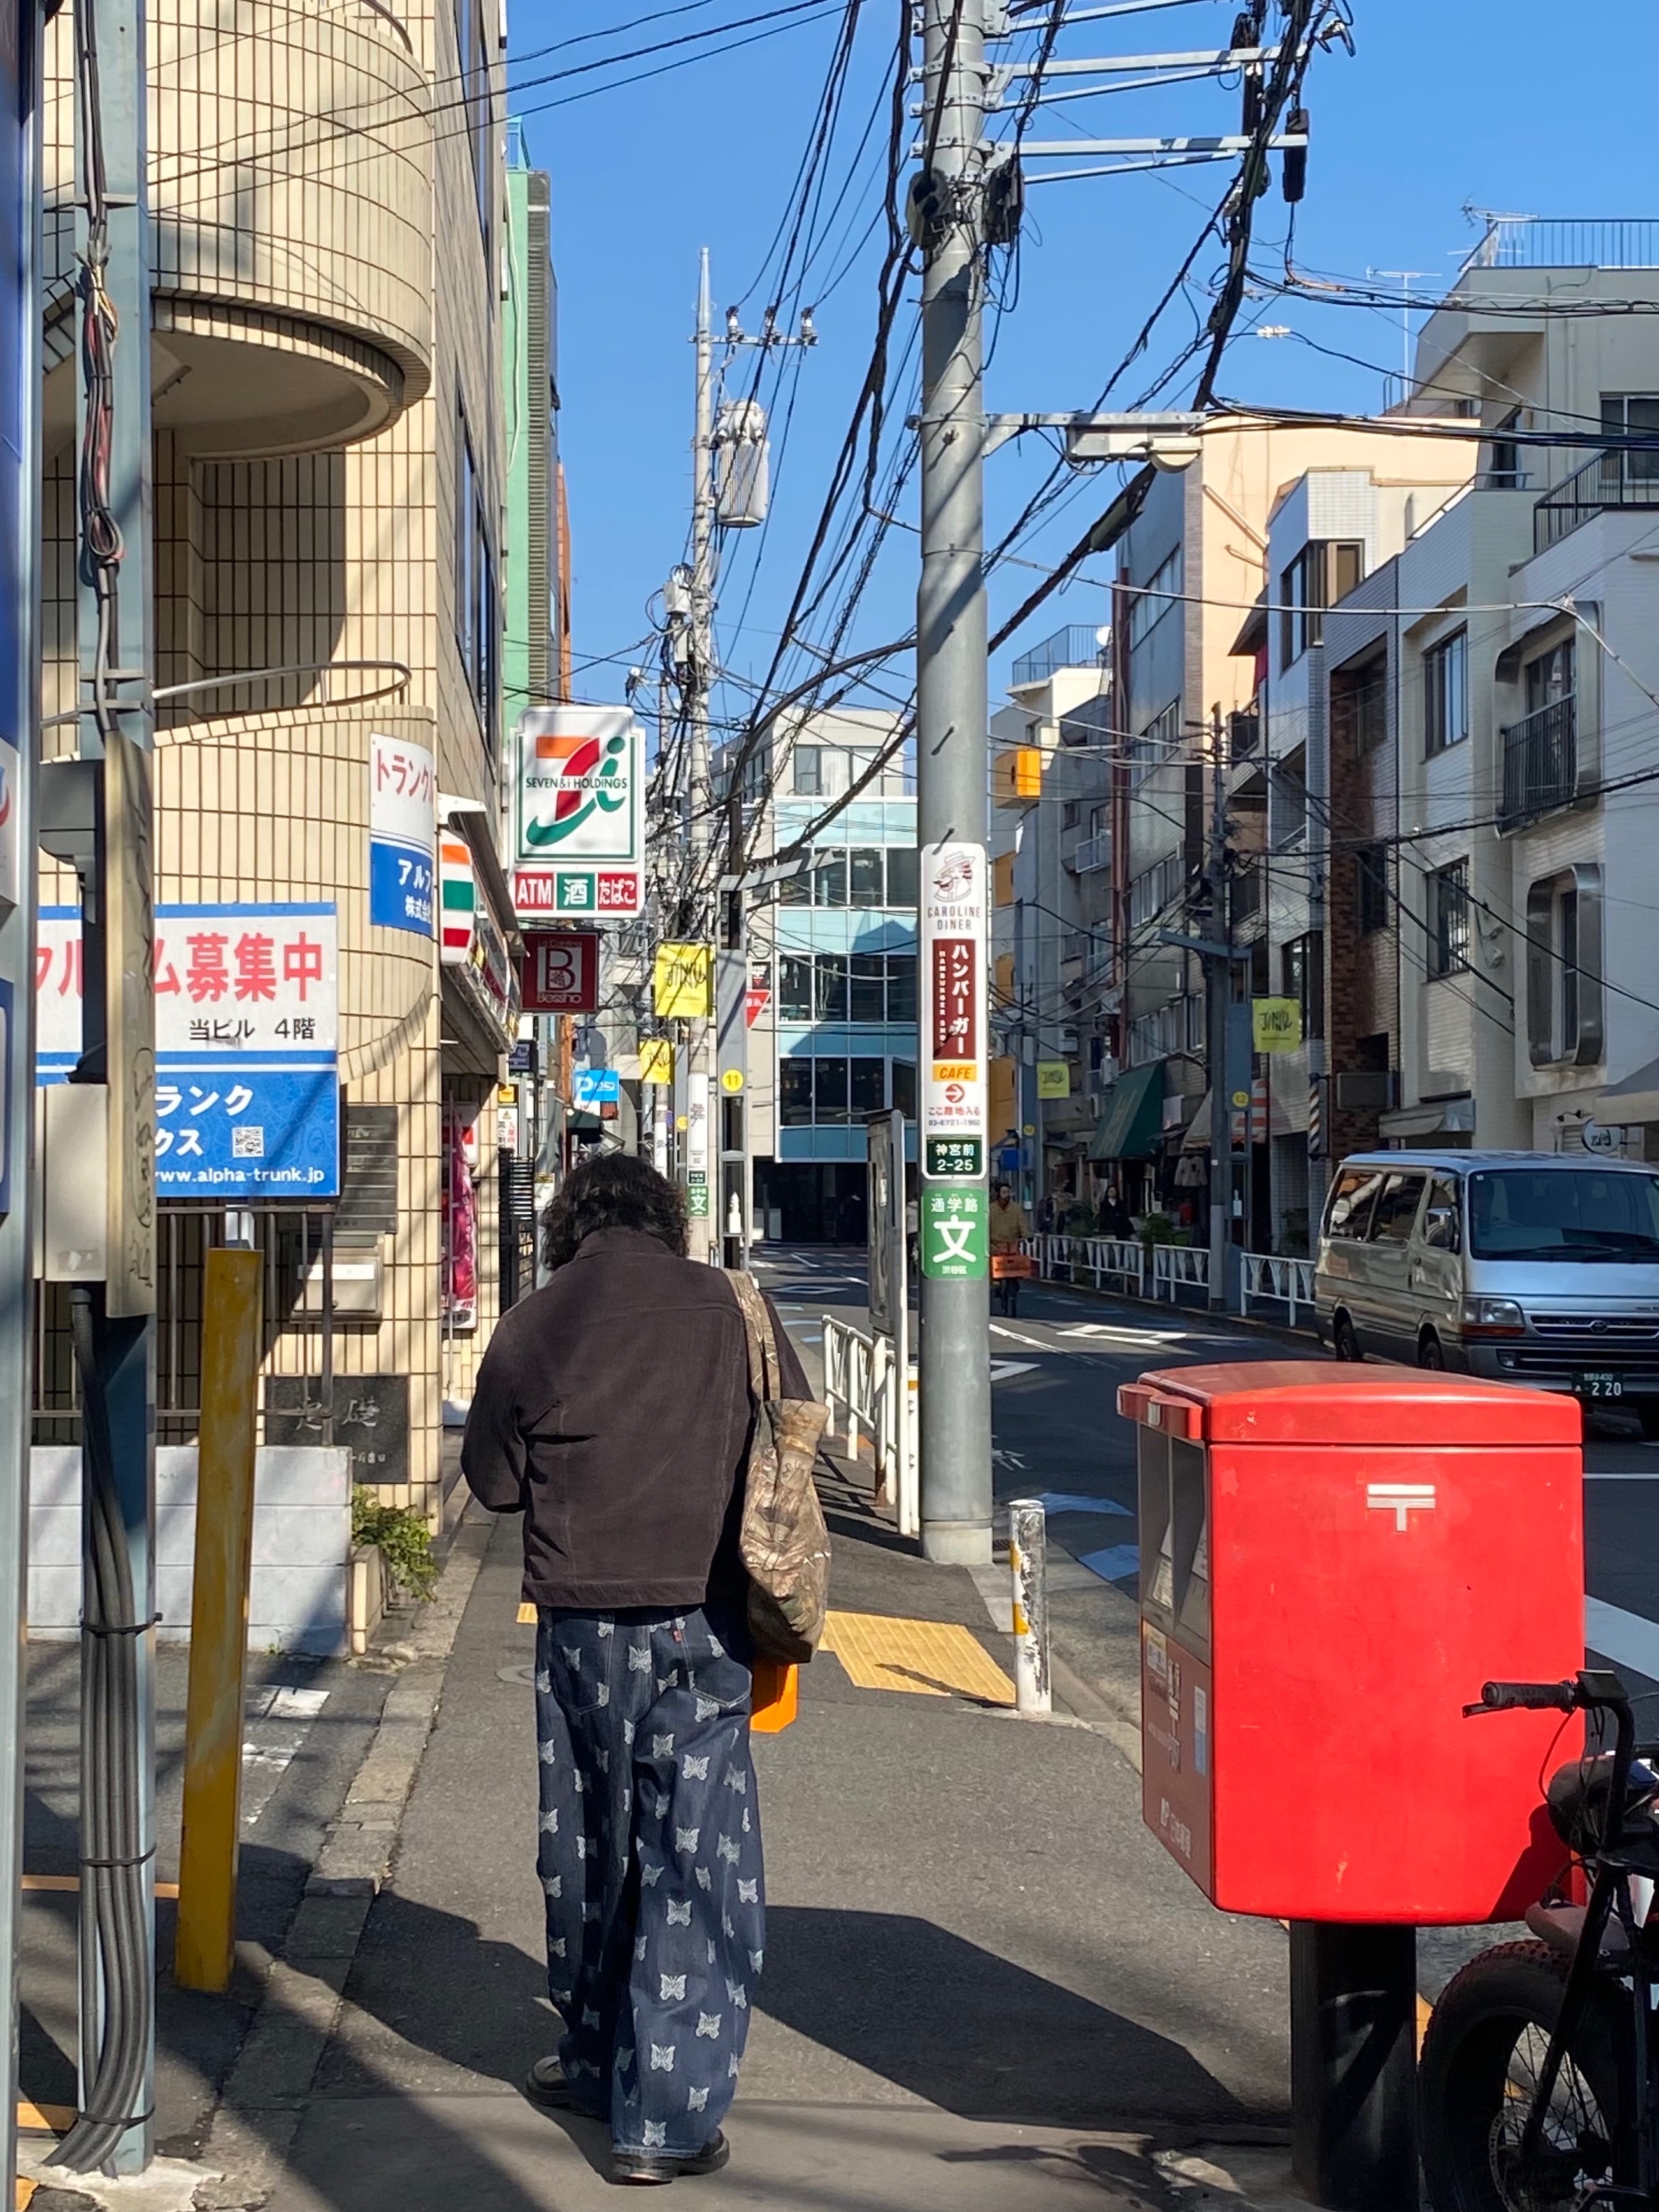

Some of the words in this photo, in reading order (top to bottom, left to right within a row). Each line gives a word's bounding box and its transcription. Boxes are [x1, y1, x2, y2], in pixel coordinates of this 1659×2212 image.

[573, 777, 628, 789] HOLDINGS
[517, 879, 552, 904] ATM
[563, 878, 588, 905] 酒
[599, 877, 636, 905] たばこ
[928, 905, 981, 919] CAROLINE
[937, 919, 972, 931] DINER
[545, 947, 576, 991] B
[951, 944, 970, 1054] ハンバーガー
[189, 1019, 255, 1040] 当ビル
[274, 1019, 316, 1040] 4階
[726, 1075, 739, 1086] 11
[939, 1066, 971, 1080] CAFE
[935, 1143, 975, 1157] 神宮前
[937, 1159, 974, 1172] 2-25
[931, 1197, 979, 1213] 通学路
[933, 1214, 977, 1263] 文
